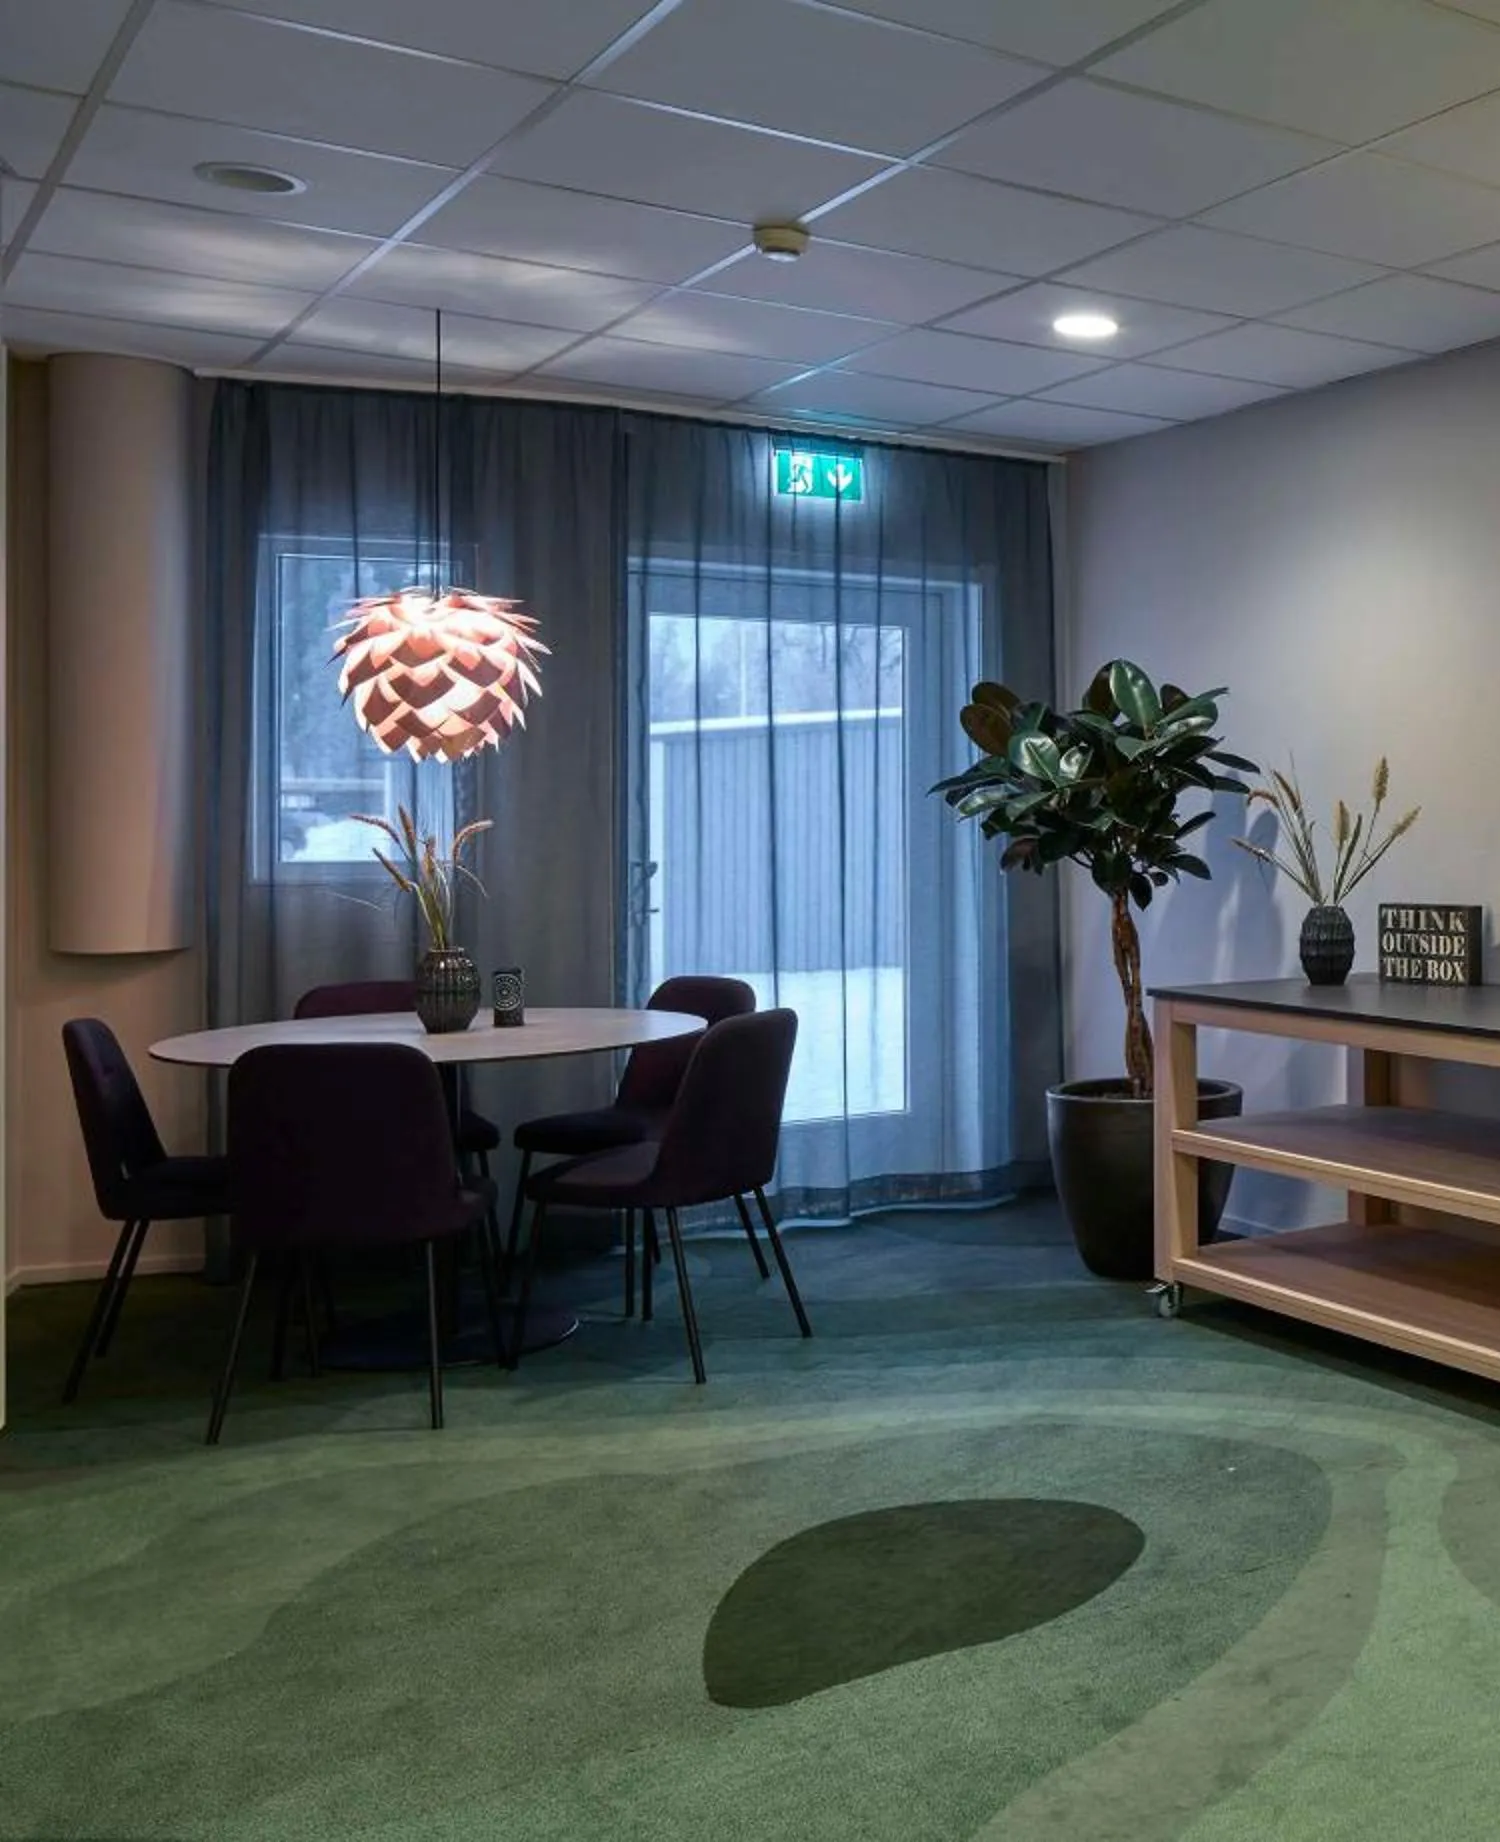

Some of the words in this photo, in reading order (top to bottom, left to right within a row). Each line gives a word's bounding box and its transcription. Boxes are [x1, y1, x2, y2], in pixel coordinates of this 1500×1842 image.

[1382, 908, 1467, 932] THINK
[1382, 931, 1465, 957] OUTSIDE
[1383, 957, 1422, 979] THE
[1426, 959, 1465, 982] BOX
